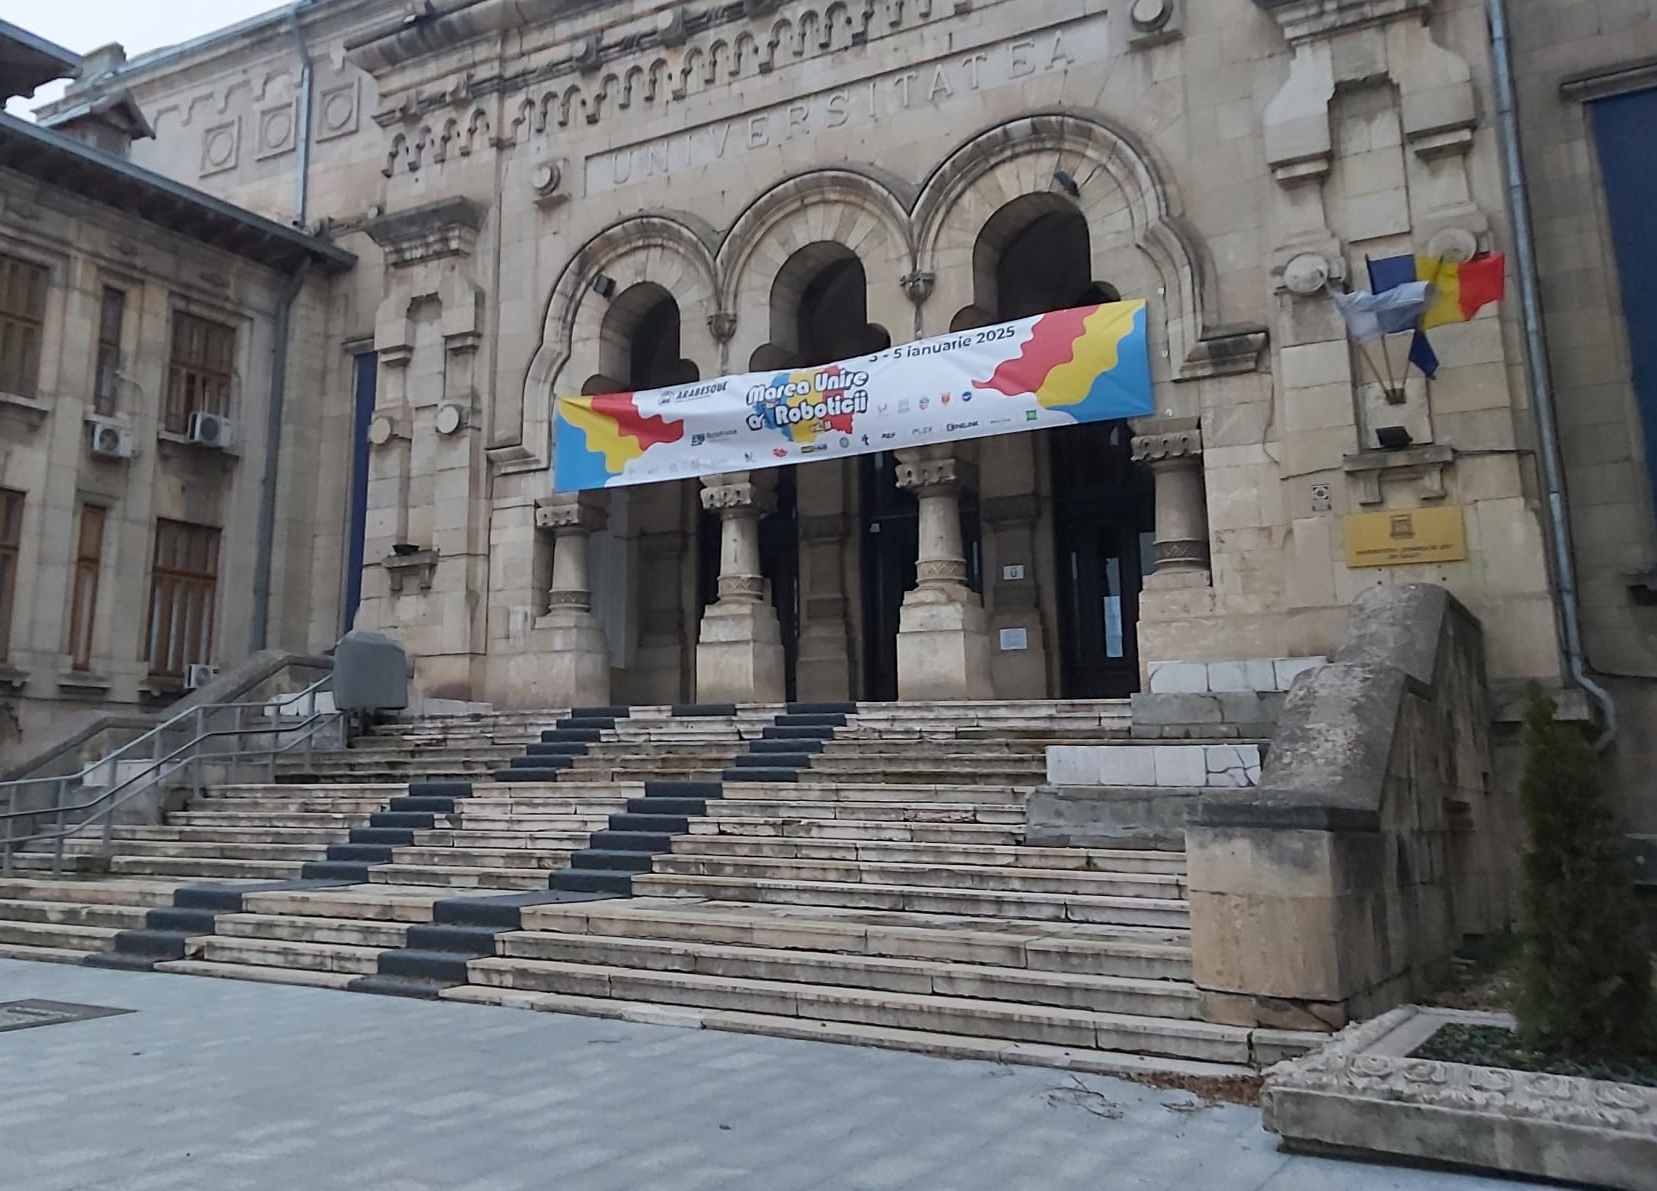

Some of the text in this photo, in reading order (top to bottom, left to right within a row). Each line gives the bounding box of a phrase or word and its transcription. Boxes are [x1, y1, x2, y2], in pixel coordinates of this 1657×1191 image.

[610, 30, 1076, 185] UNIVERSITATEA
[893, 347, 902, 359] 5
[906, 336, 972, 358] ianuarie
[976, 325, 1016, 344] 2025
[676, 381, 728, 400] ARABESQUE
[746, 368, 869, 405] Marea Unire
[774, 390, 869, 427] Roboticii
